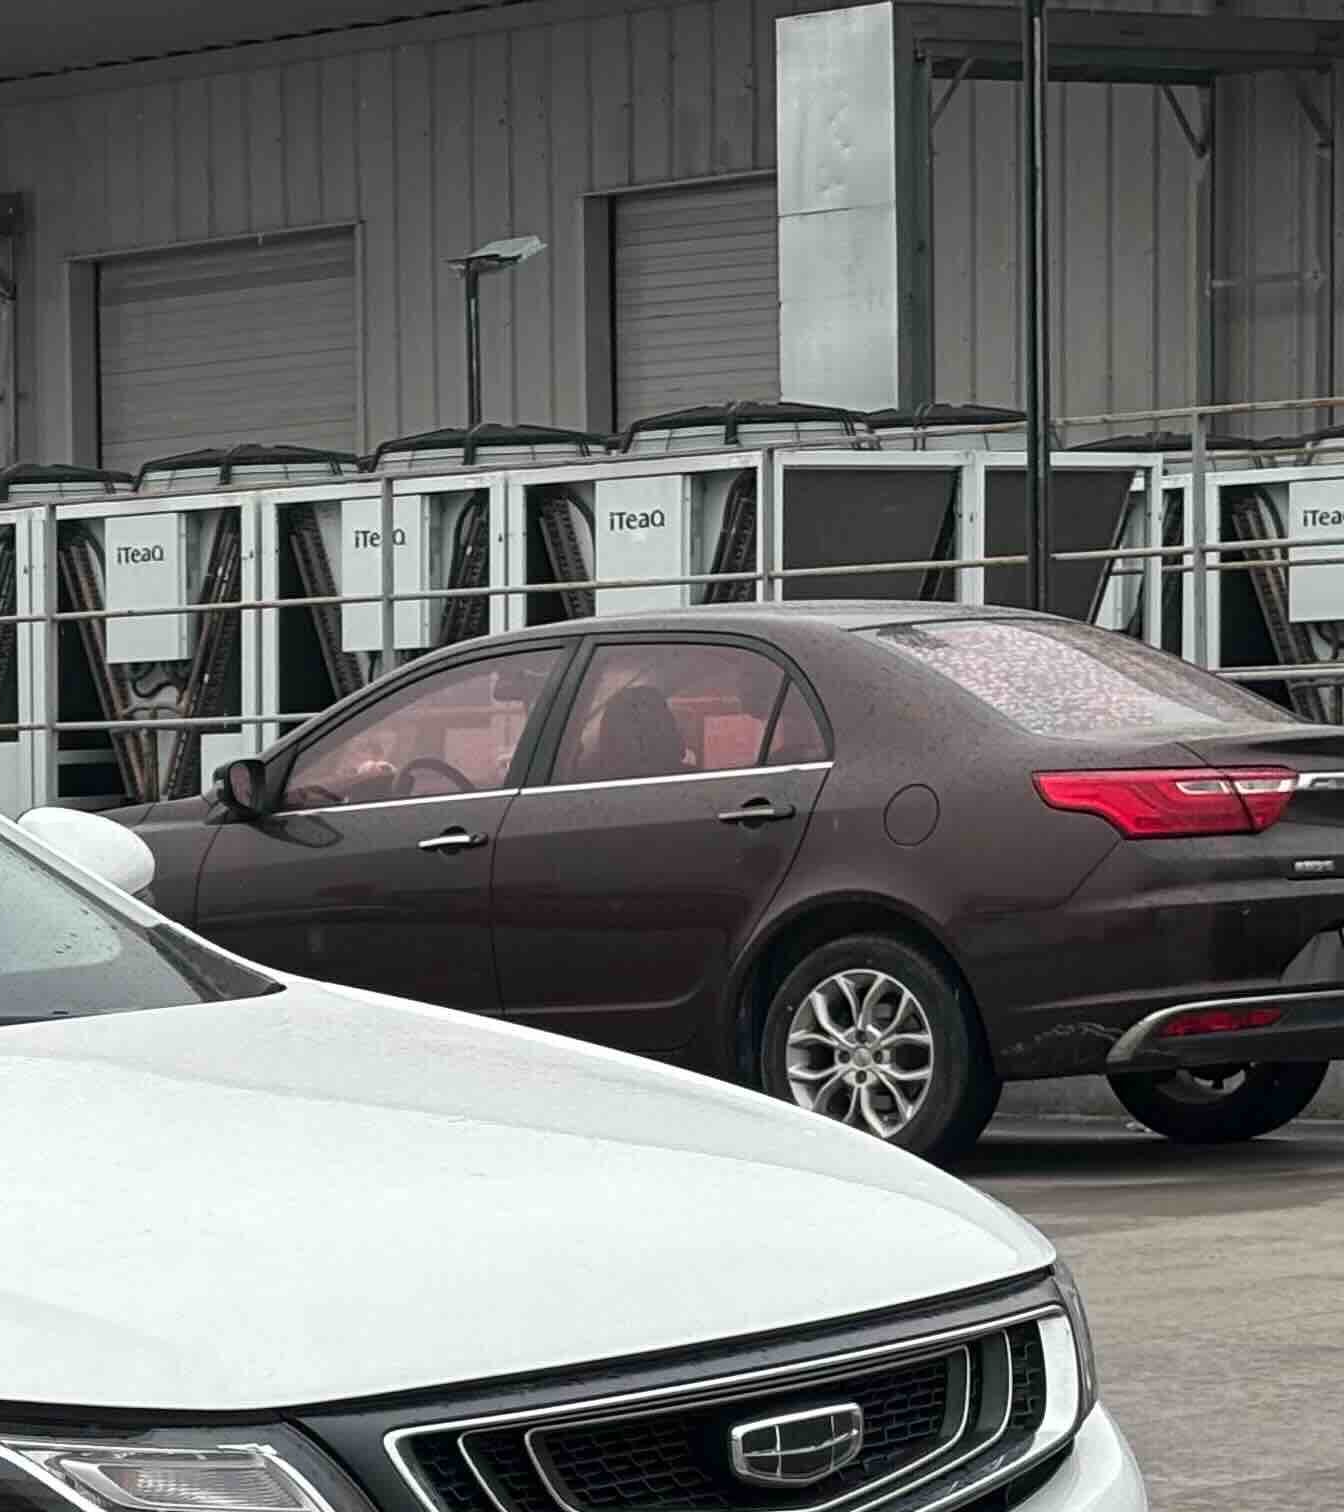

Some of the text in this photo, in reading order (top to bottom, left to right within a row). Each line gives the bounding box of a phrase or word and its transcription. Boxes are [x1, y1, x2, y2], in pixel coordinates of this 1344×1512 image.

[609, 509, 665, 532] iTeaQ
[1302, 509, 1344, 527] iTea
[354, 528, 406, 549] iTeQ
[117, 544, 164, 565] iTeaQ
